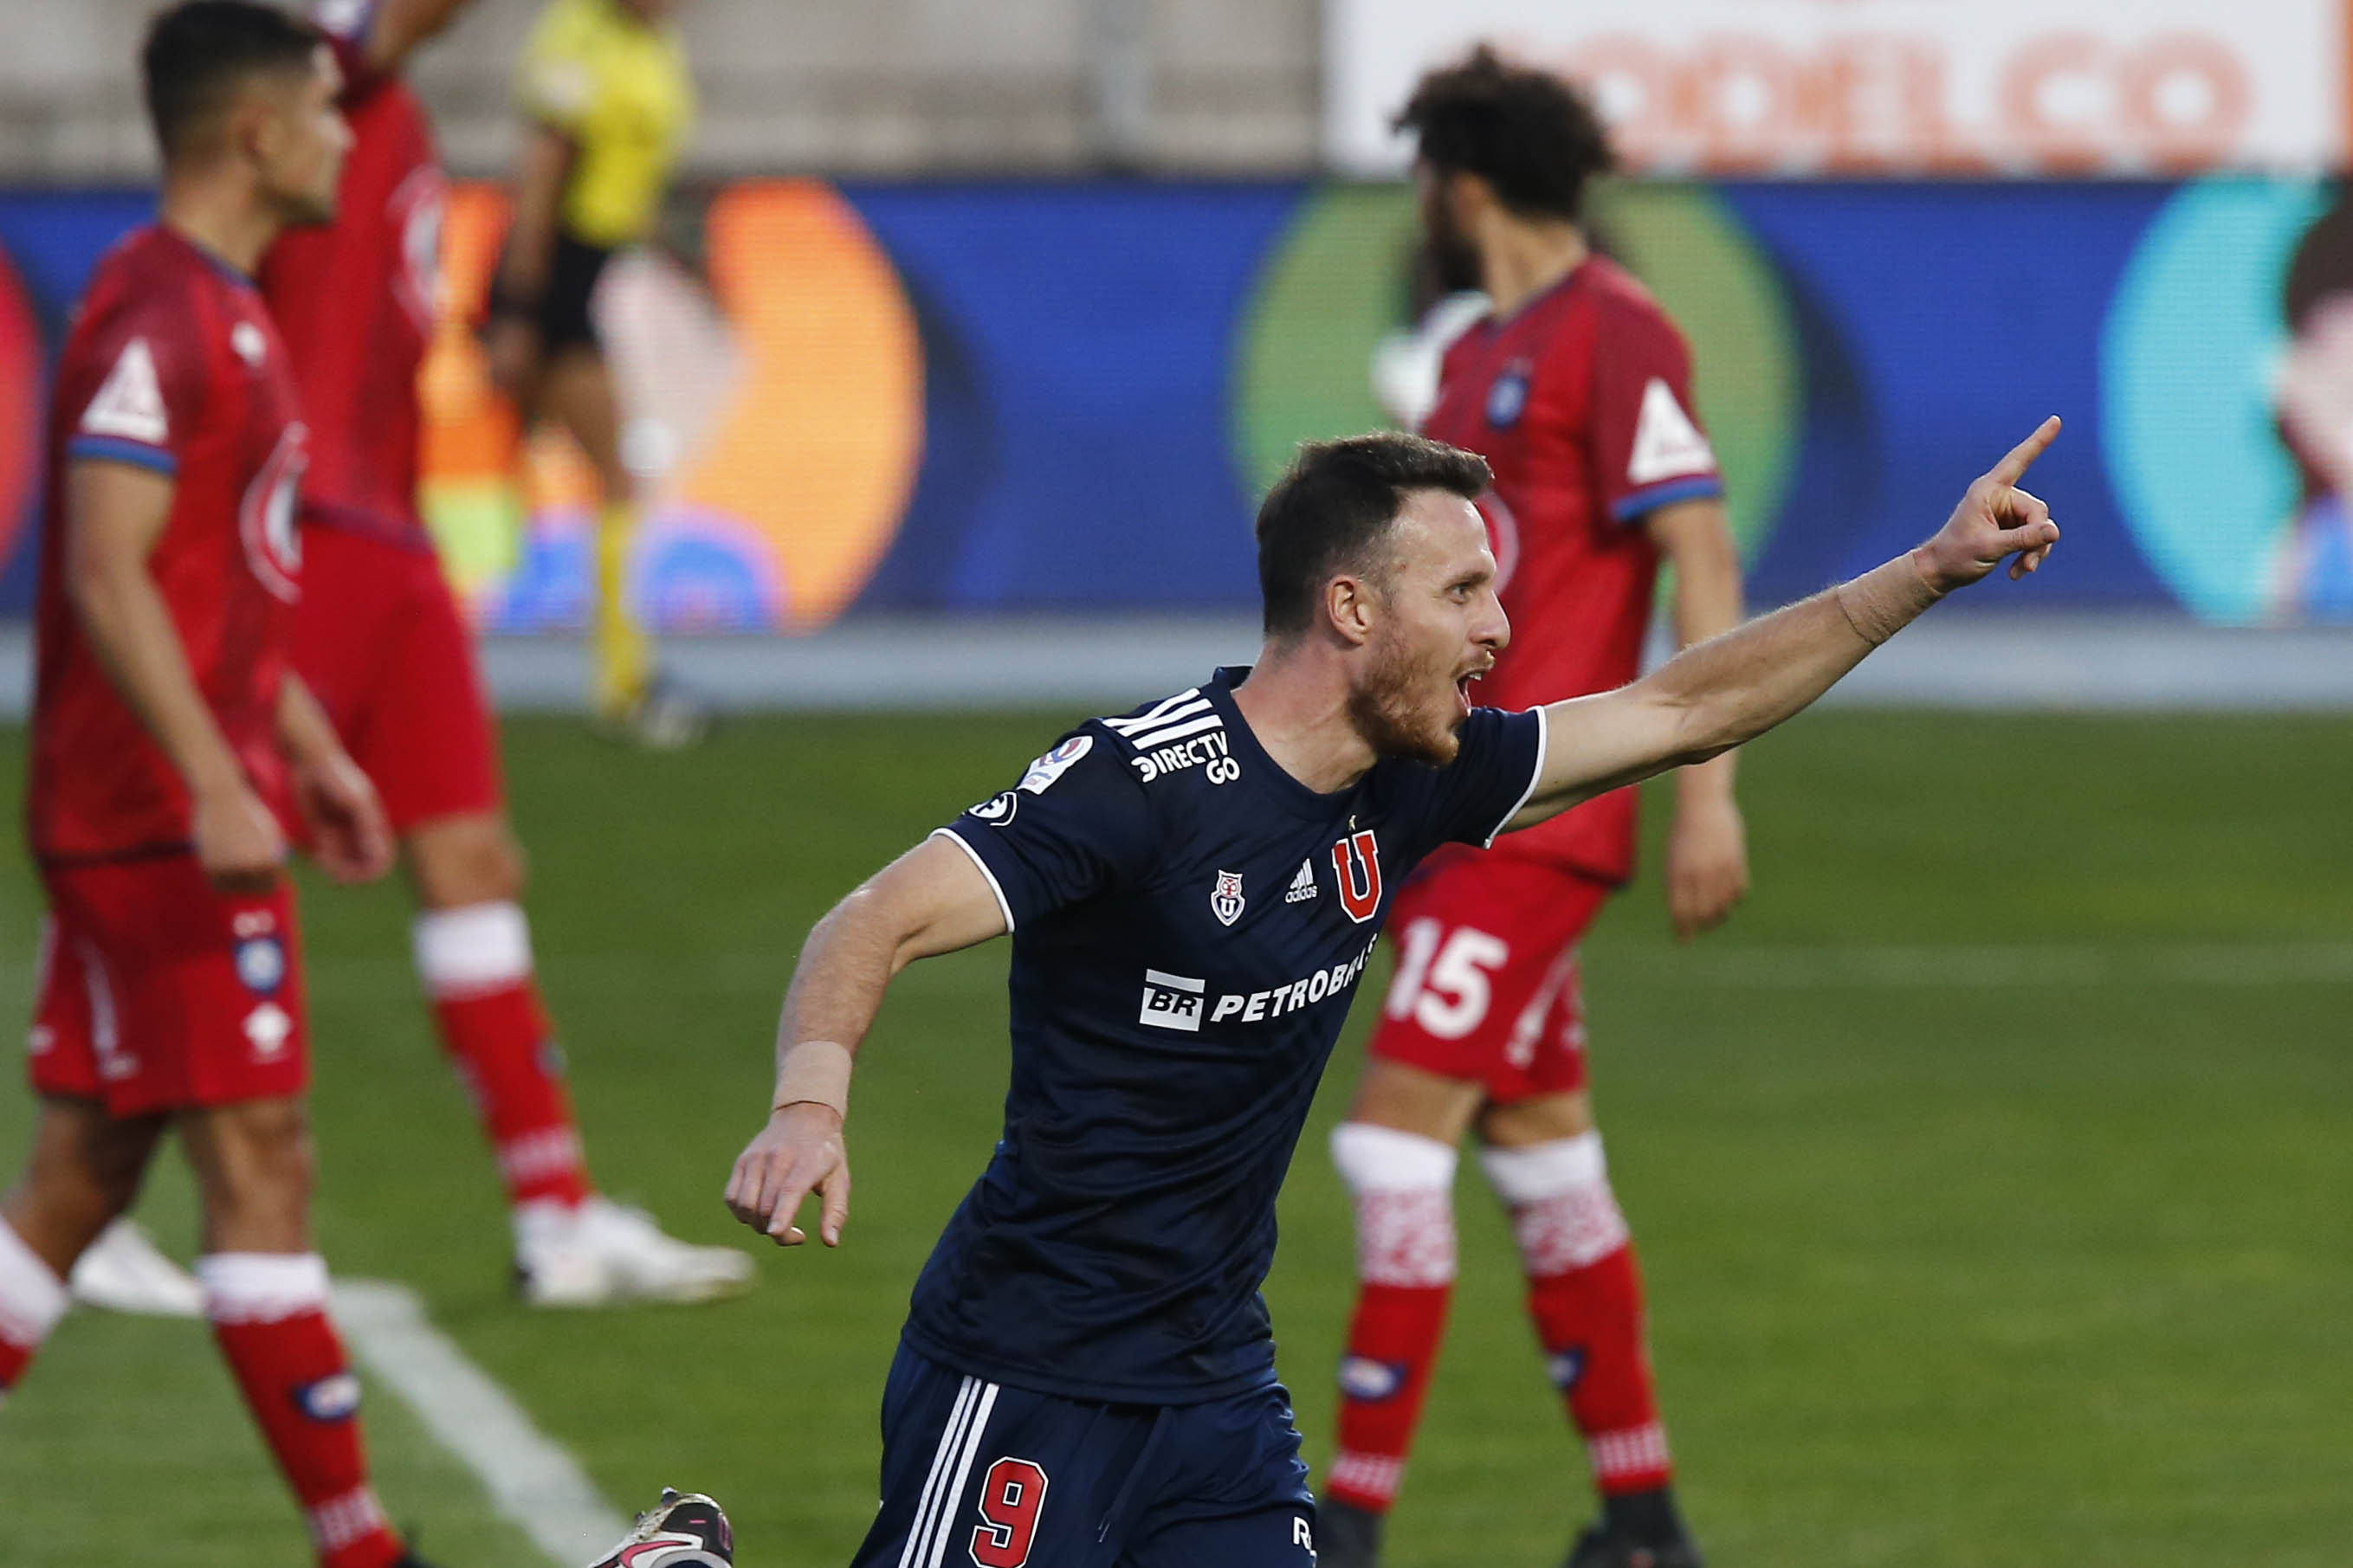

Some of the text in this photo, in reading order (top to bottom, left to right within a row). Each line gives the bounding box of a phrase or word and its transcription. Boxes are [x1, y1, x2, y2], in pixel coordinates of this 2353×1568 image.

[1472, 29, 2257, 171] ODELCO
[1130, 730, 1230, 784] DIRECTV
[1206, 756, 1241, 785] GO
[1284, 884, 1318, 904] adidas
[1331, 829, 1384, 925] U
[1147, 988, 1199, 1018] BR
[1387, 916, 1511, 1042] 15
[968, 1455, 1050, 1568] 9
